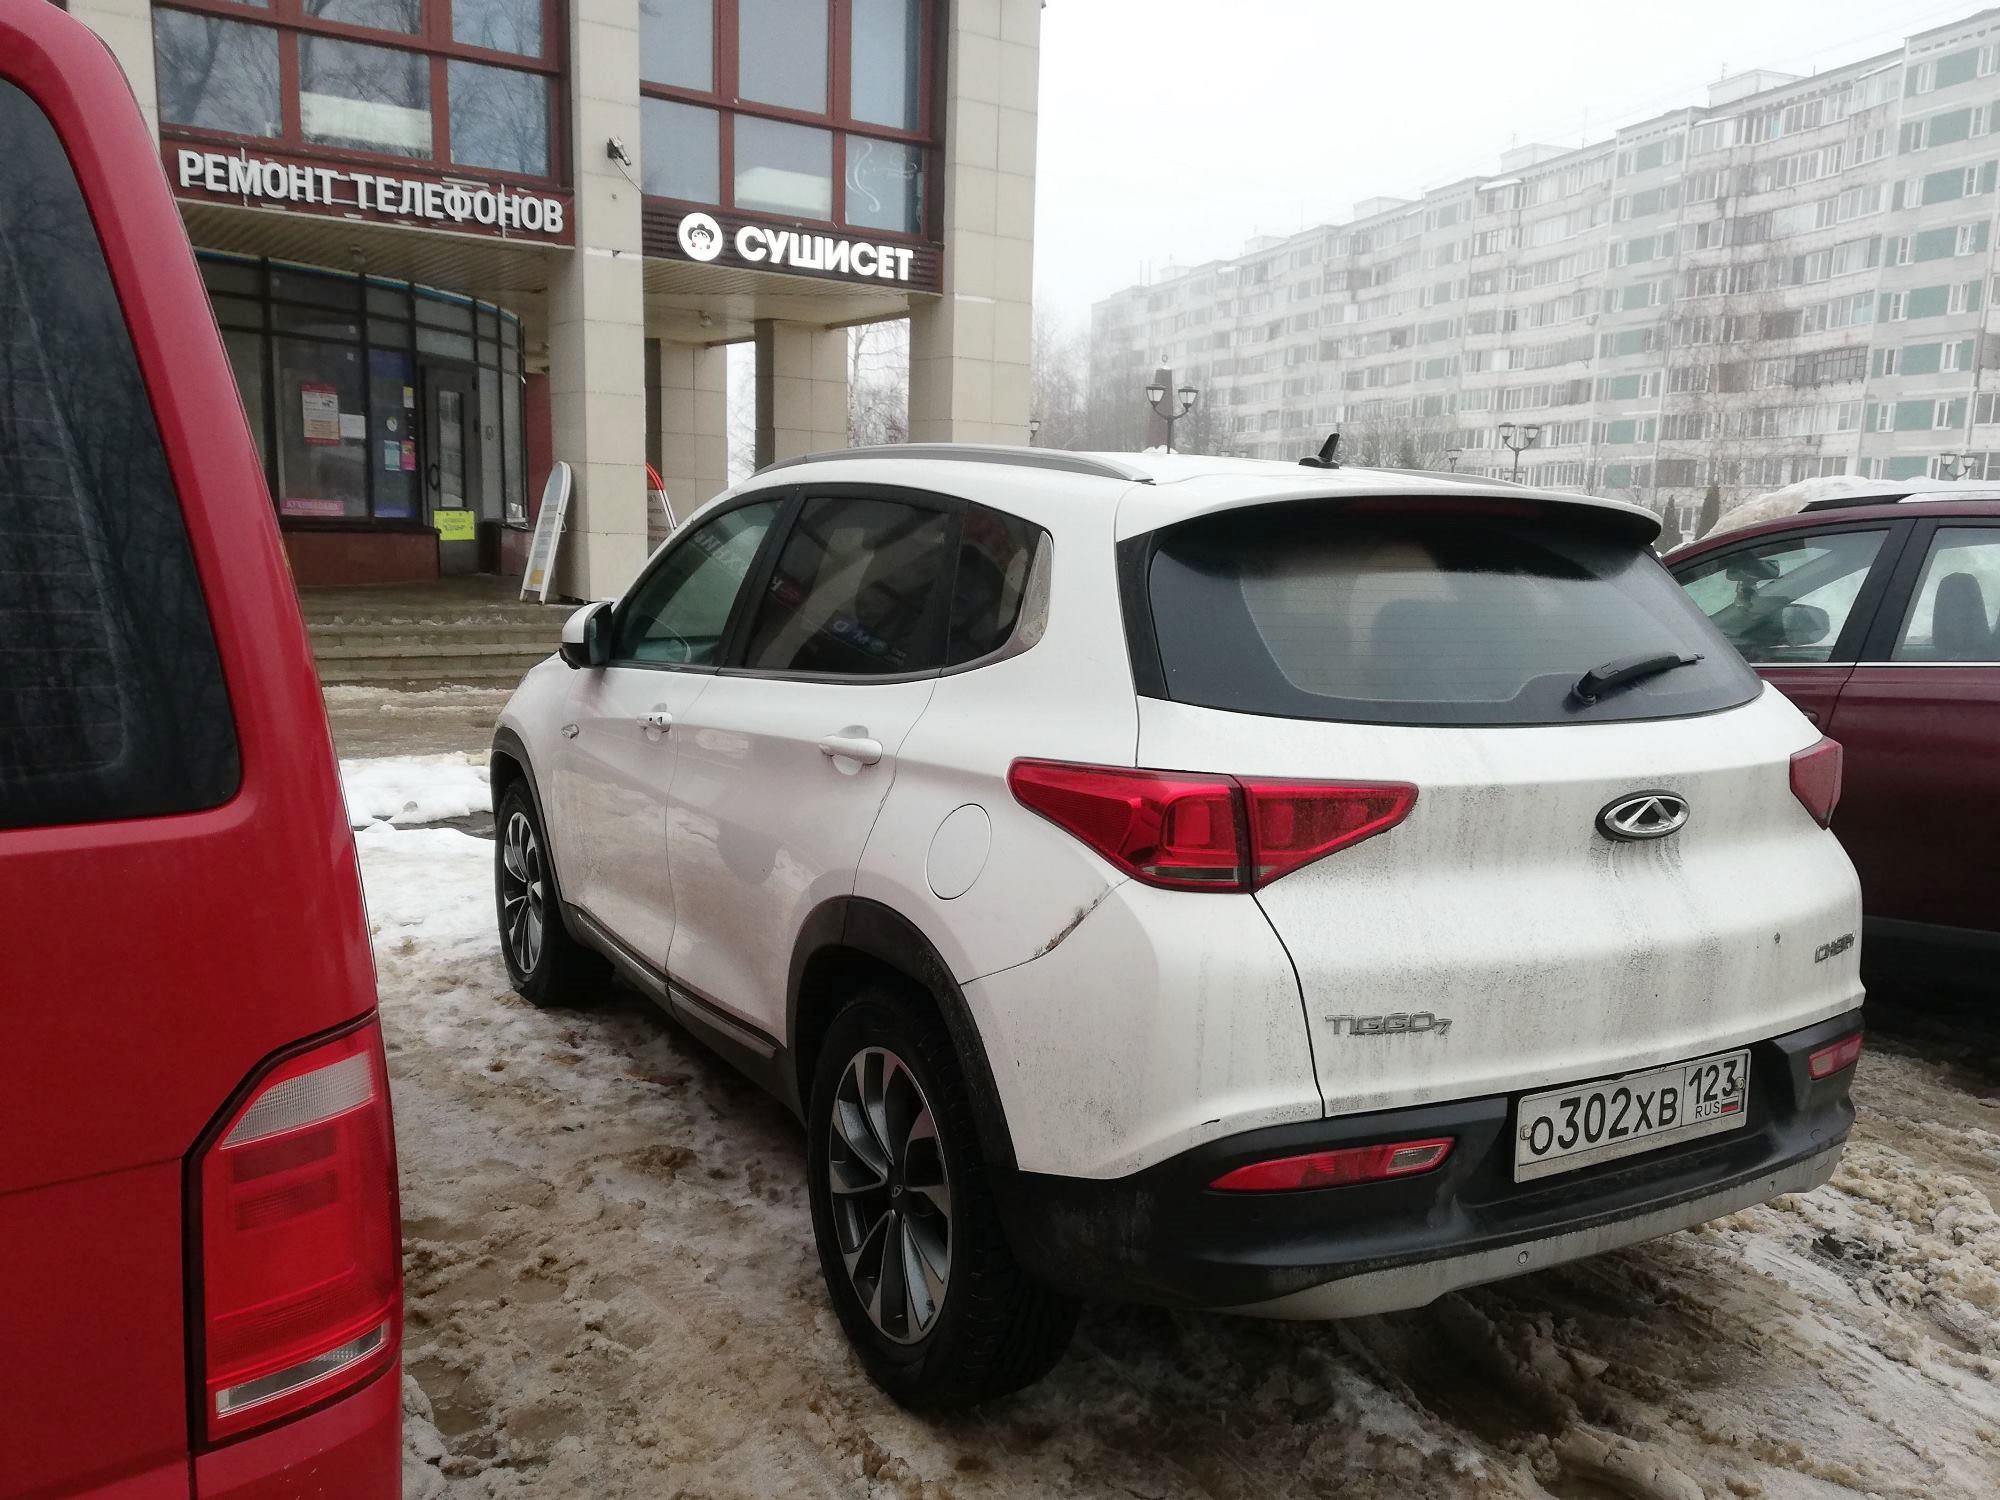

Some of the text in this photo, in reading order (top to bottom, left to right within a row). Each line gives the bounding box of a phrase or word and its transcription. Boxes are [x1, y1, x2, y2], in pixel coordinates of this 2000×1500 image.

[178, 149, 564, 234] РЕМОНТ ТЕЛЕФОНОВ
[734, 225, 914, 281] СУШИСЕТ
[1688, 1059, 1738, 1105] 123
[1695, 1100, 1721, 1119] RUS
